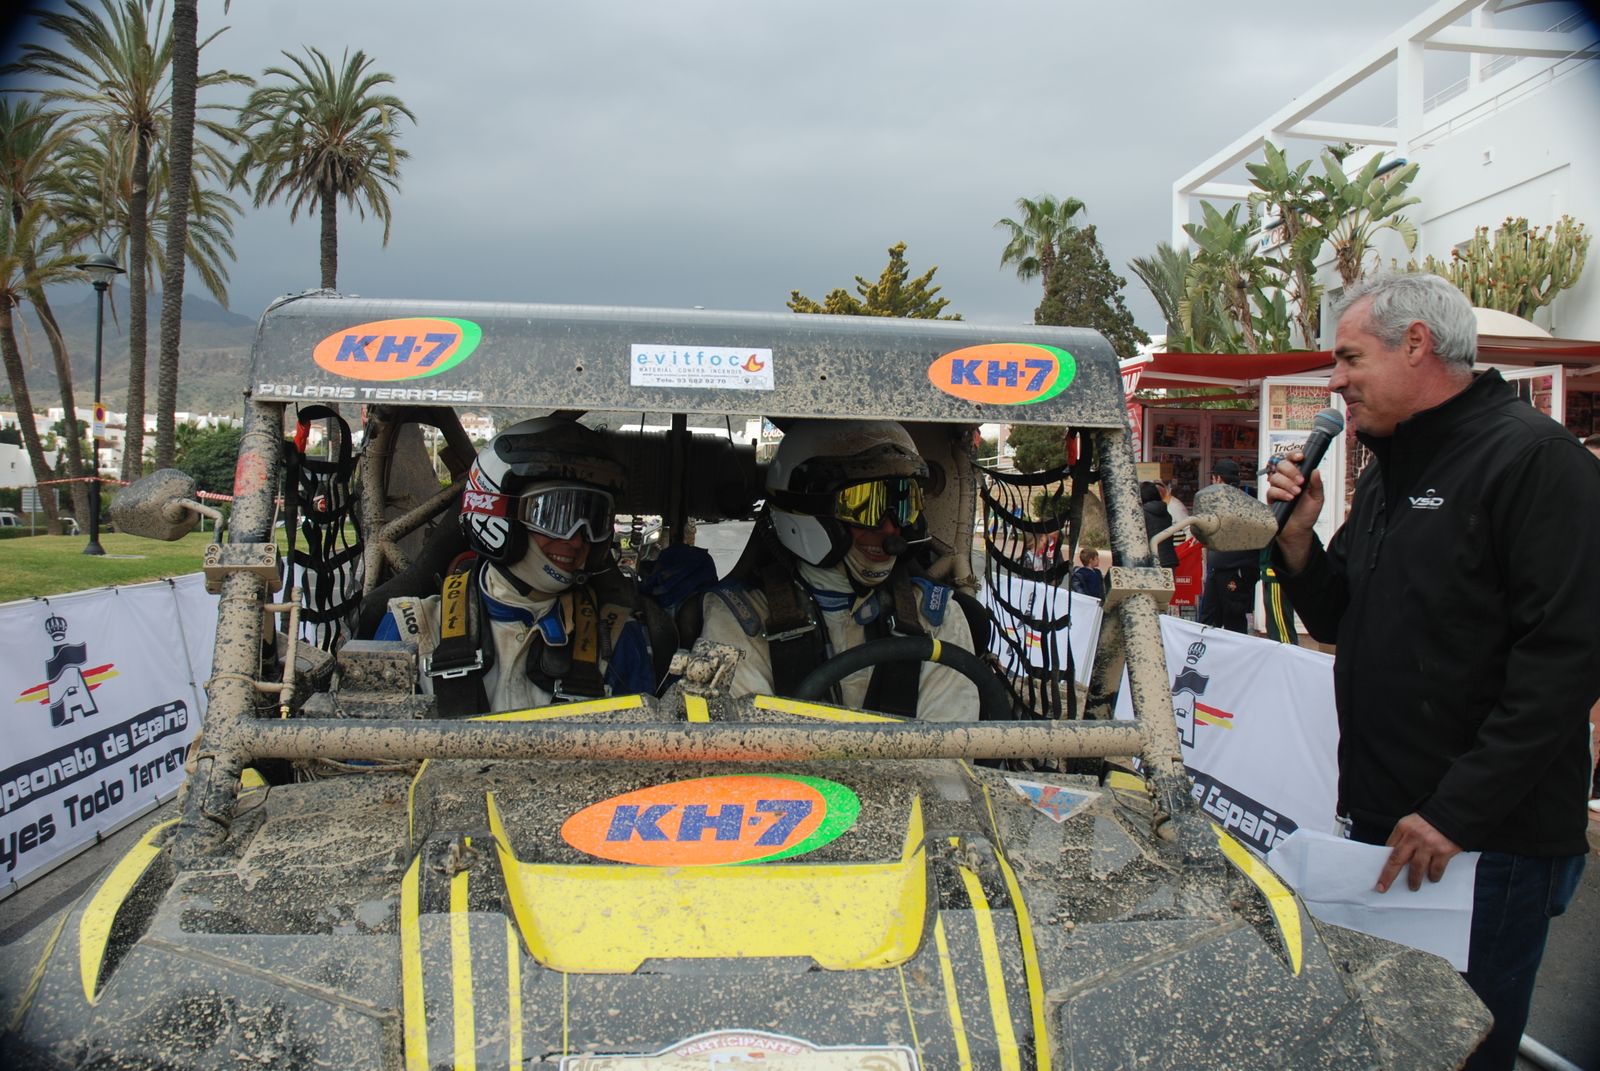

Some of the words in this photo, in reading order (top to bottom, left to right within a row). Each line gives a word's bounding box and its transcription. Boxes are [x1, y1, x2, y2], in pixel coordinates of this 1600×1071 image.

[637, 351, 740, 366] evitfoc
[258, 383, 356, 399] POLARIS
[360, 387, 484, 402] TERRASSA
[1408, 496, 1445, 507] VSD
[0, 747, 97, 813] peonato
[102, 733, 130, 760] de
[130, 705, 188, 747] España
[64, 780, 124, 829] Todo
[675, 1036, 801, 1056] PARTICIPANTE
